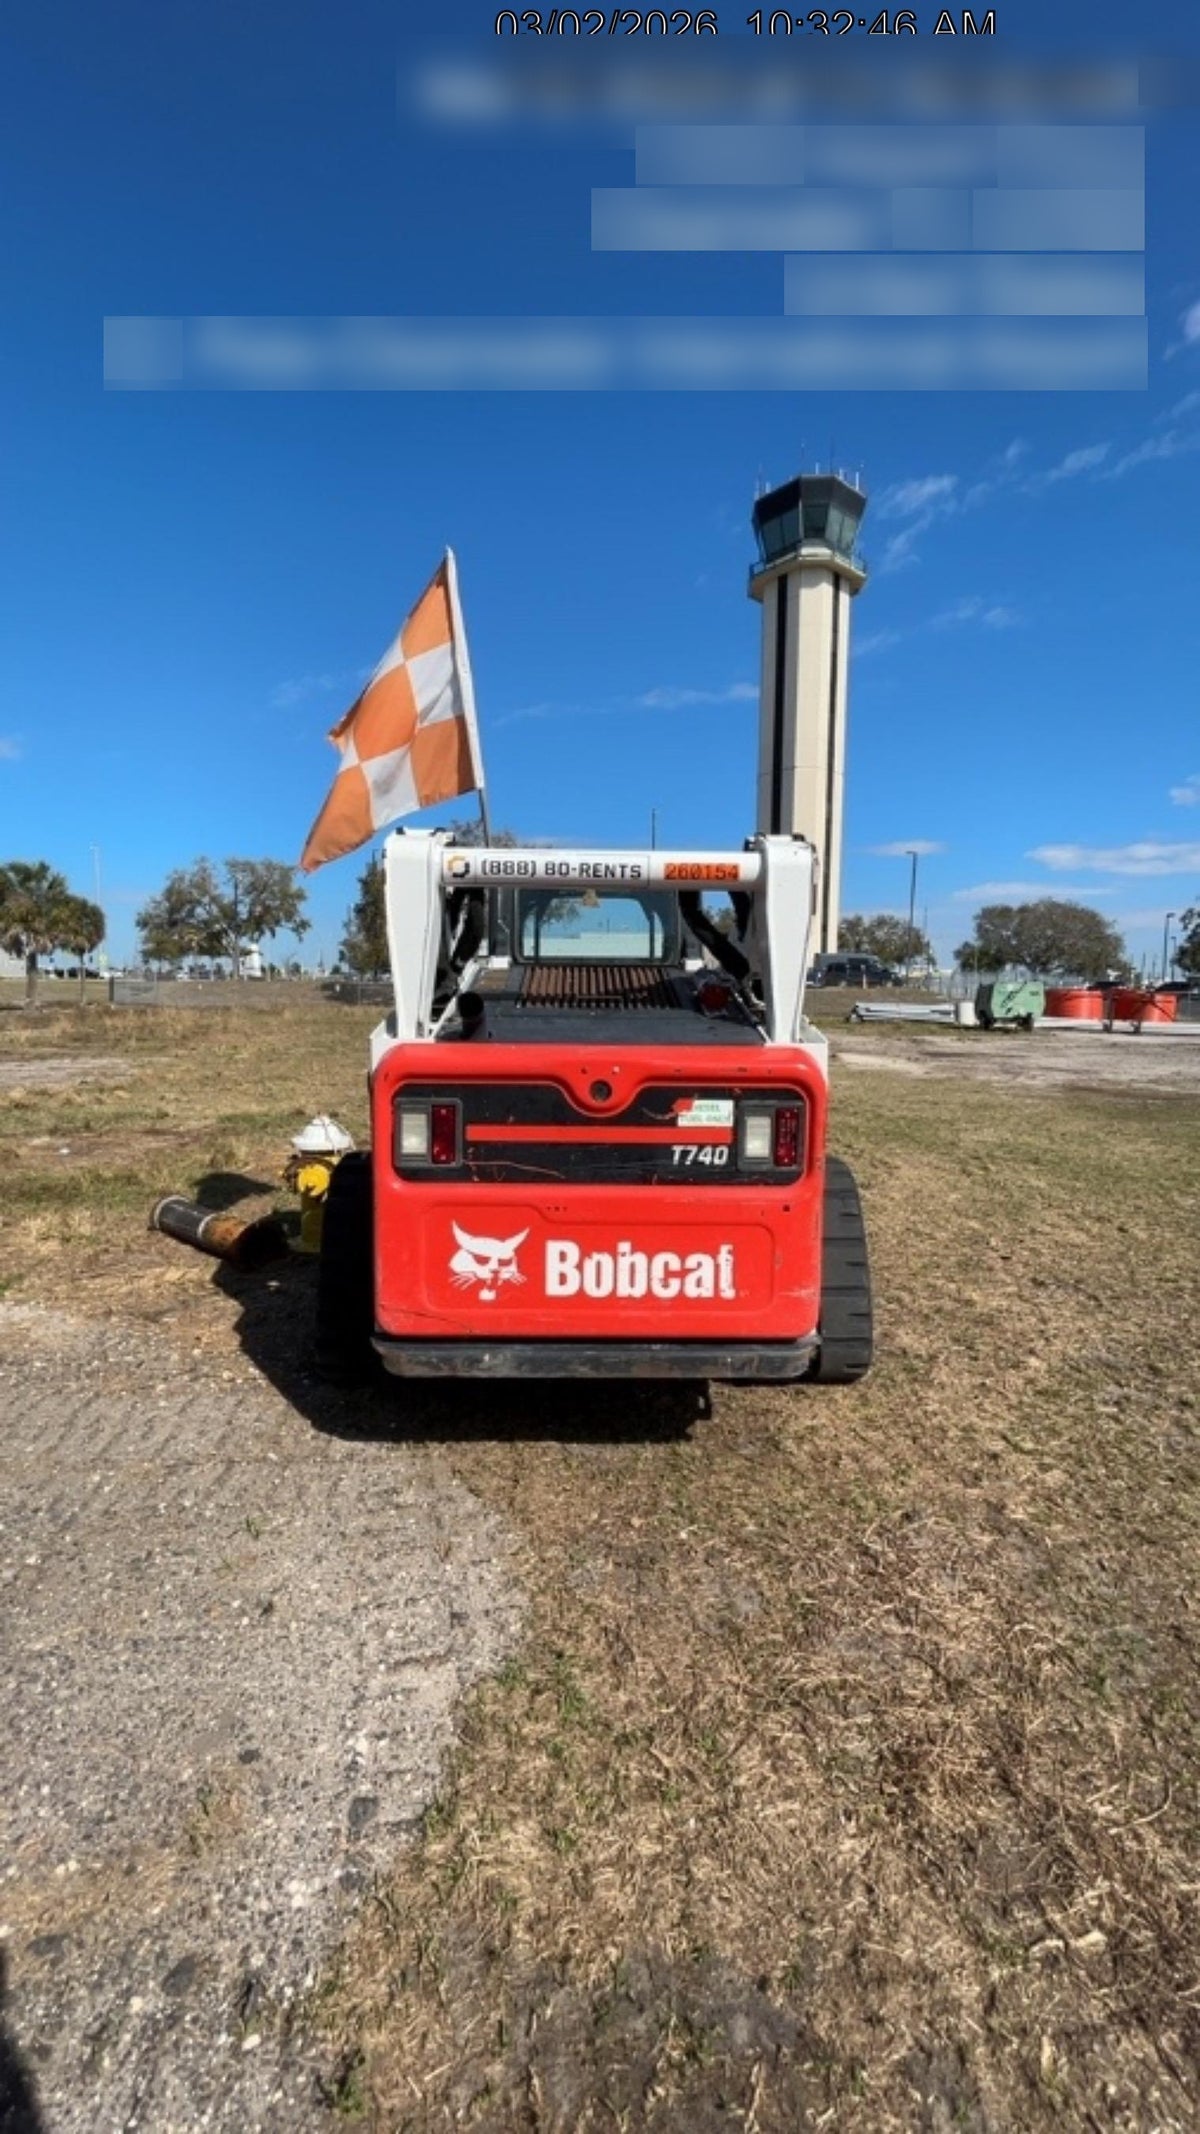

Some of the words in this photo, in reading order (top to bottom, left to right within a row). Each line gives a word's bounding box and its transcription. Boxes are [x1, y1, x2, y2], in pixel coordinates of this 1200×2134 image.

[481, 859, 537, 878] (888)
[671, 1145, 729, 1165] T740
[544, 1239, 737, 1300] Bobcat
